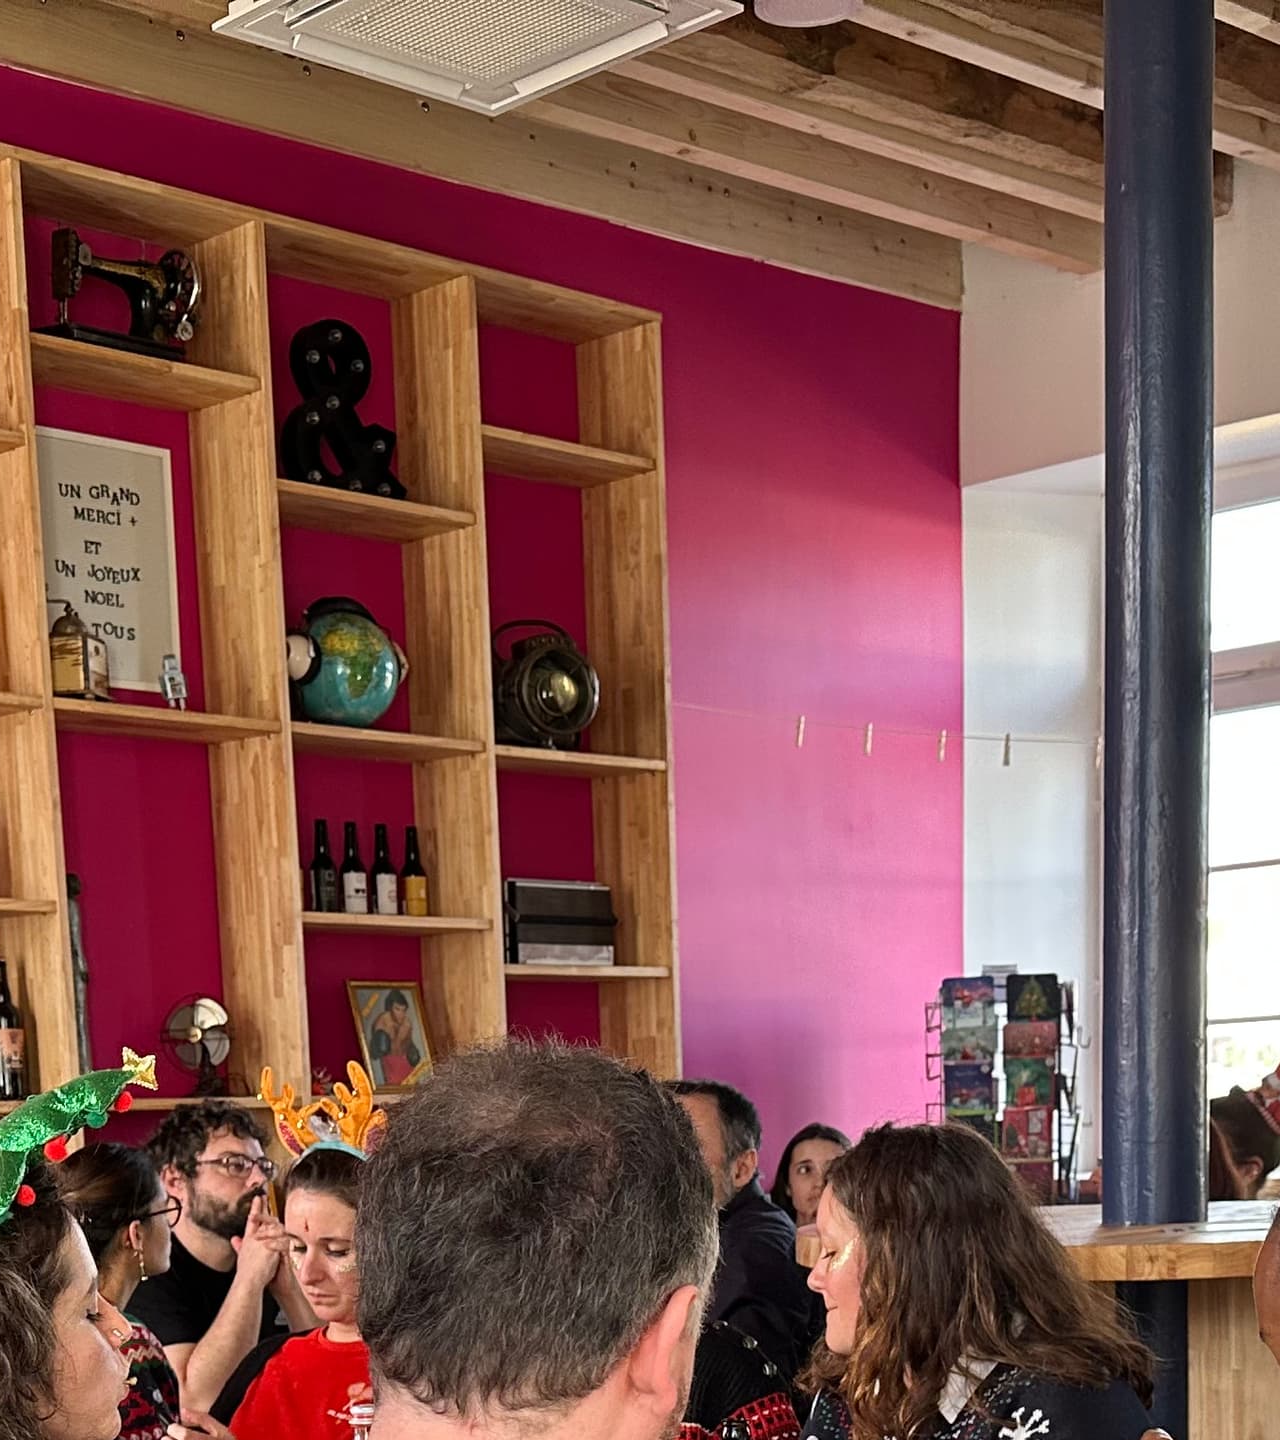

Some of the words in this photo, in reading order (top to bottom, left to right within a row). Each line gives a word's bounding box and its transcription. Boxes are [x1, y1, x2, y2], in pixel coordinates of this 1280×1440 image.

[57, 482, 82, 500] UN
[88, 483, 141, 507] GRAND
[73, 505, 121, 527] MERCI
[83, 539, 102, 555] ET
[54, 558, 76, 578] UN
[87, 563, 141, 585] JOYEUX
[83, 589, 125, 609] NOEL
[91, 621, 136, 641] TOUS
